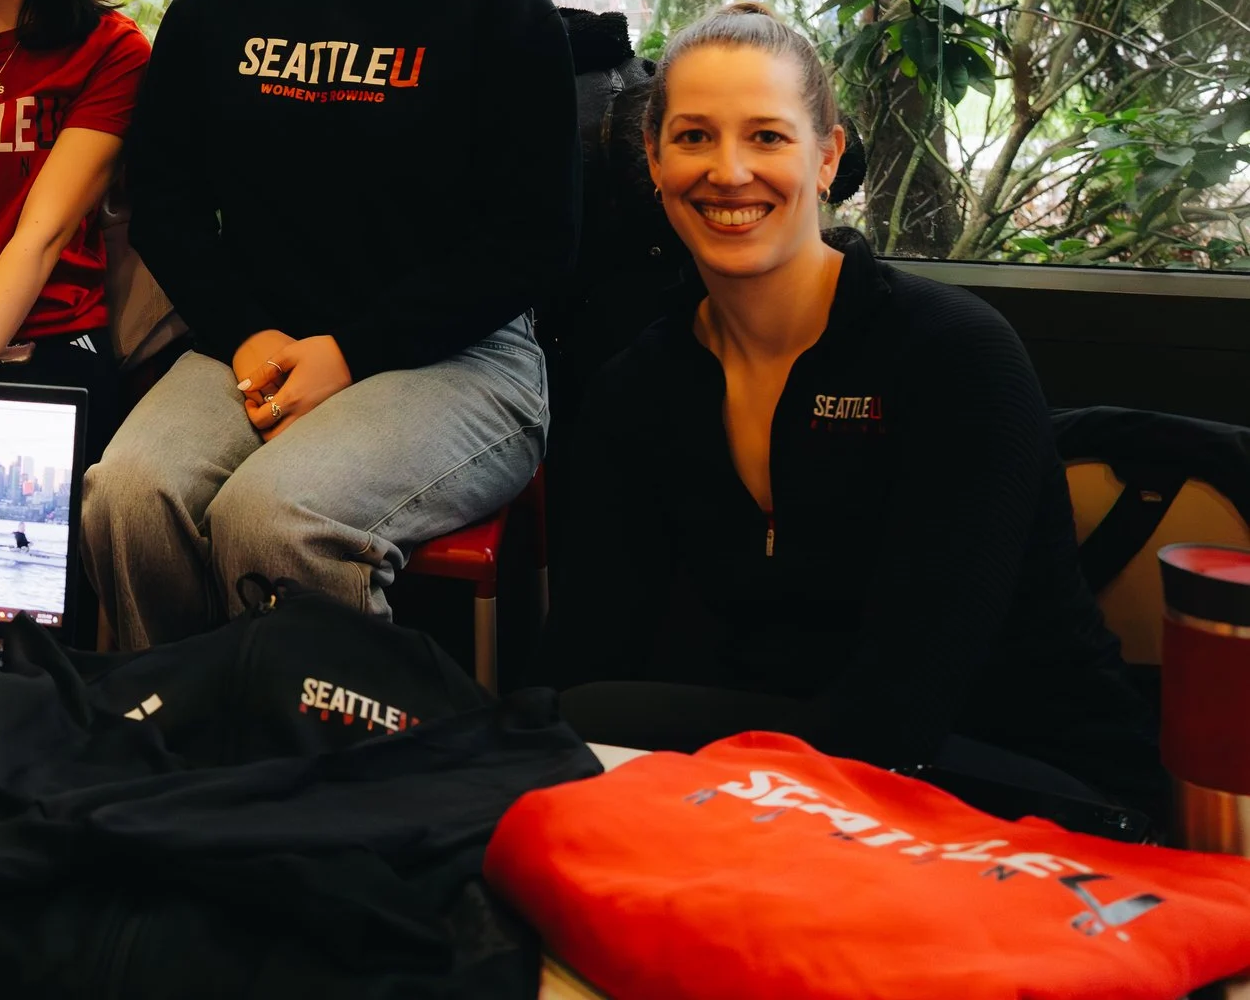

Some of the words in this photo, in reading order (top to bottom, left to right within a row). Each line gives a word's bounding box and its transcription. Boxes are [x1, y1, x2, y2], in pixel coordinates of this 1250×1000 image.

[238, 37, 427, 88] SEATTLEU
[260, 83, 328, 104] WOMEN'S
[329, 89, 386, 104] ROWING
